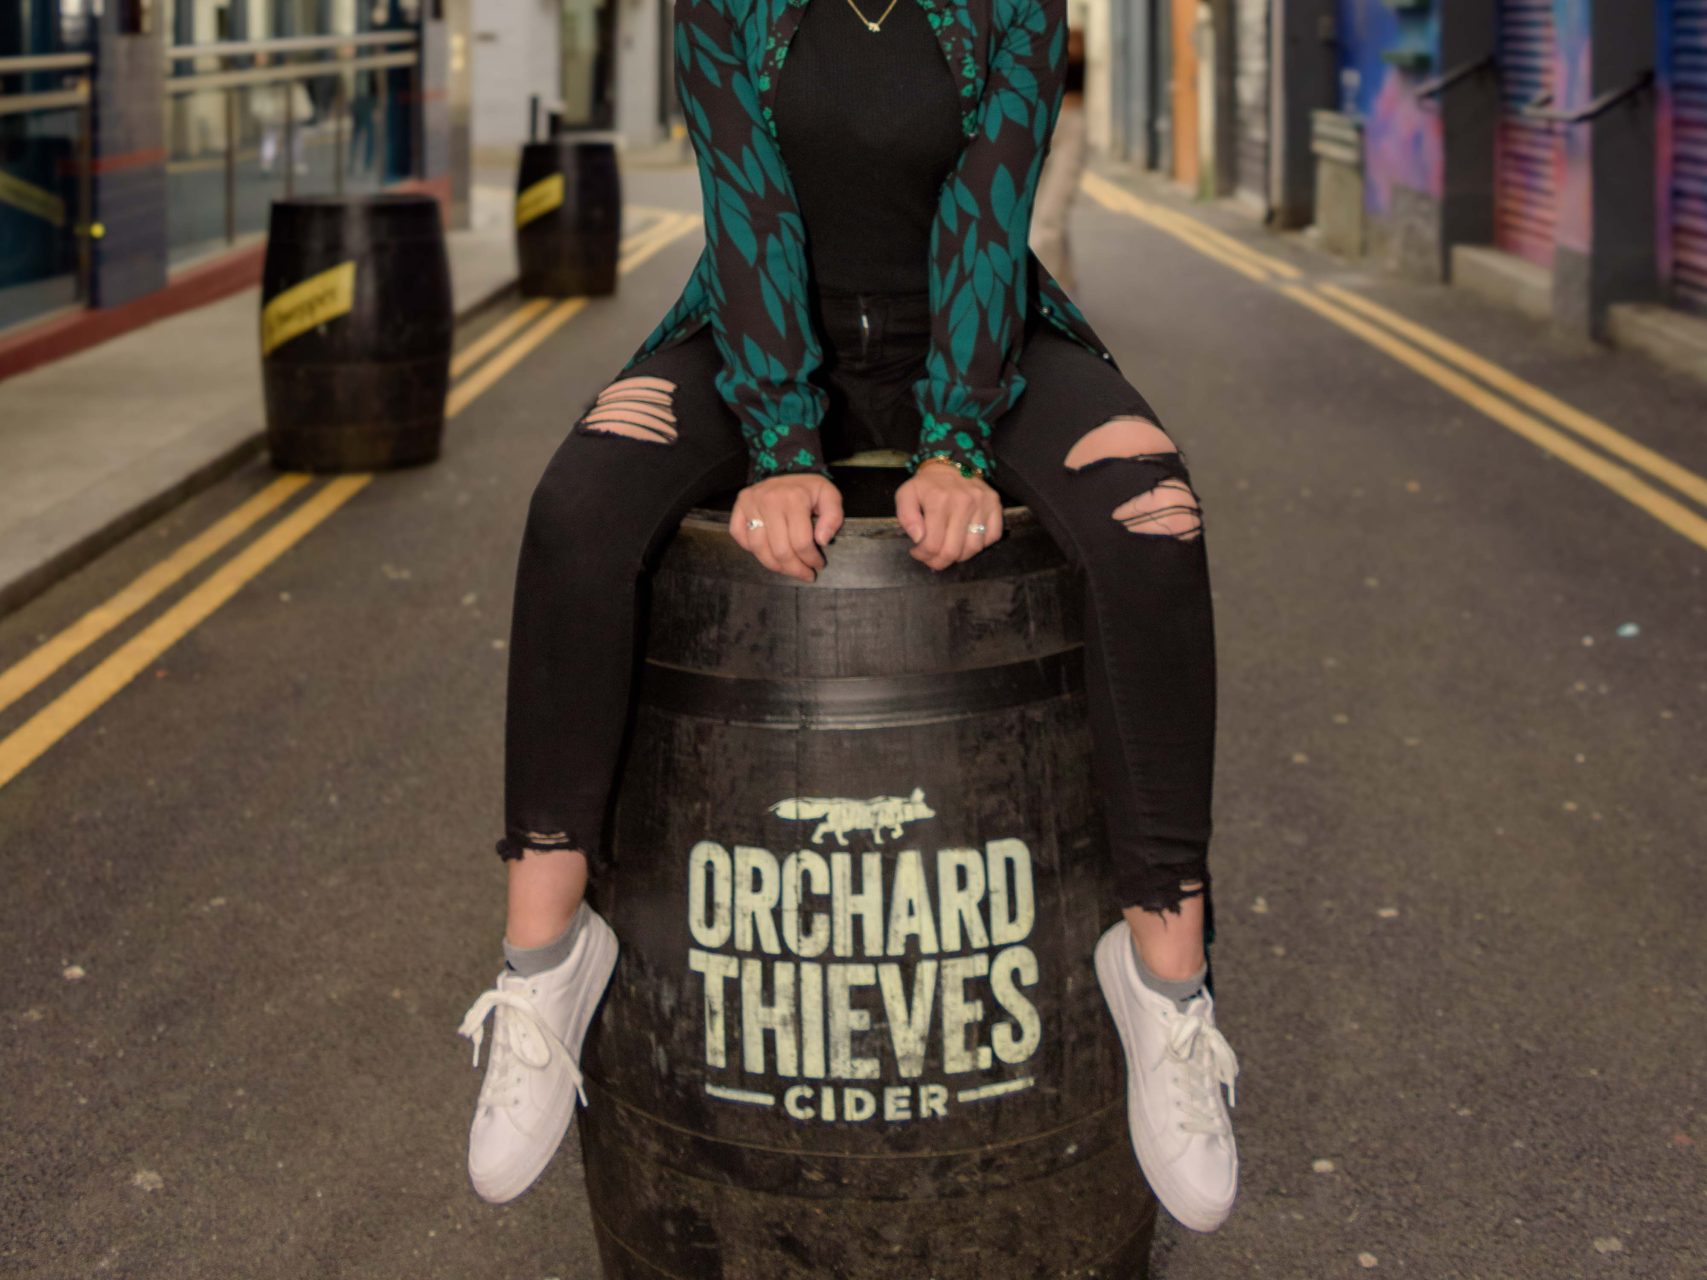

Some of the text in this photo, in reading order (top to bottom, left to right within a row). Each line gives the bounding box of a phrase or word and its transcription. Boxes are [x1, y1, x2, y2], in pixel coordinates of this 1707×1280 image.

[688, 838, 1036, 958] ORCHARD
[688, 945, 1041, 1080] THIEVES
[784, 1085, 949, 1122] CIDER
